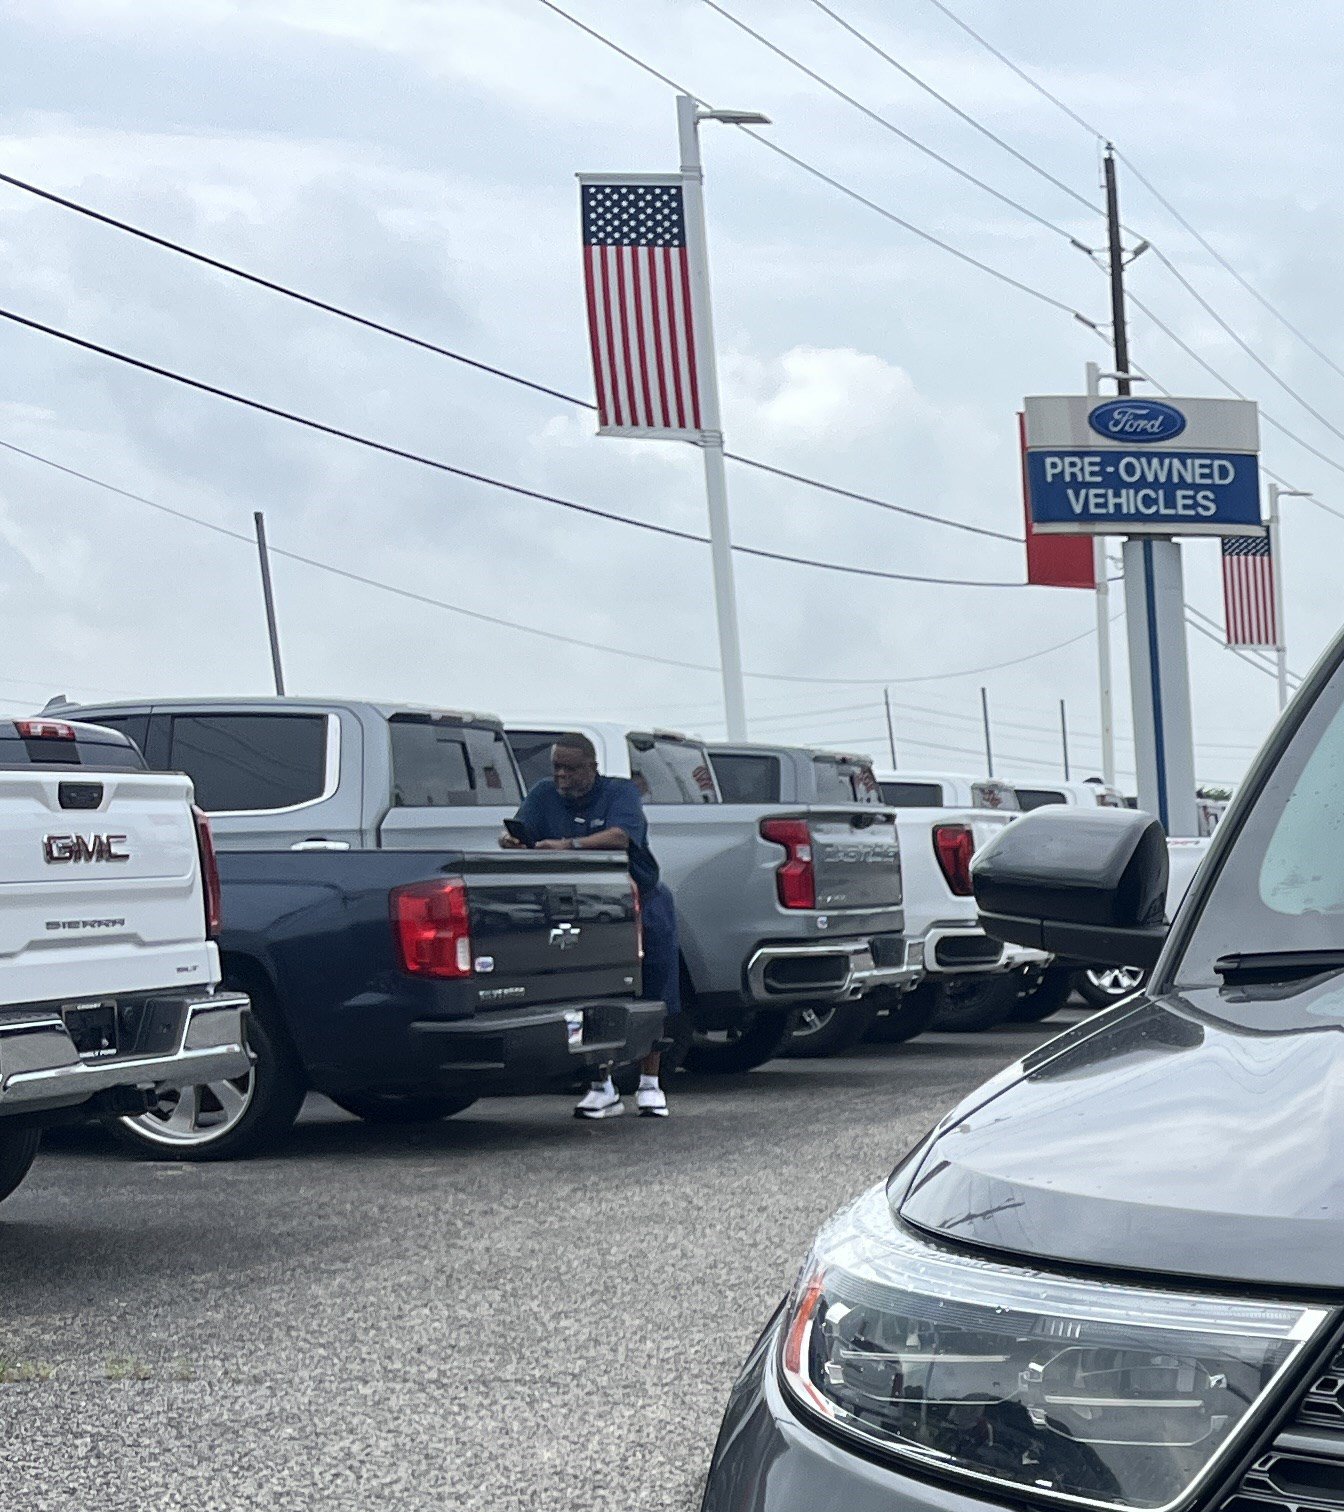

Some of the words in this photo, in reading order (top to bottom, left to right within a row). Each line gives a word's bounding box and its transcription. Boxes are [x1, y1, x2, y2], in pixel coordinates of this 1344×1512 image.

[1109, 408, 1163, 434] Ford
[1067, 489, 1217, 516] VEHICLES
[43, 833, 130, 864] GMC
[46, 918, 125, 930] SIERRA
